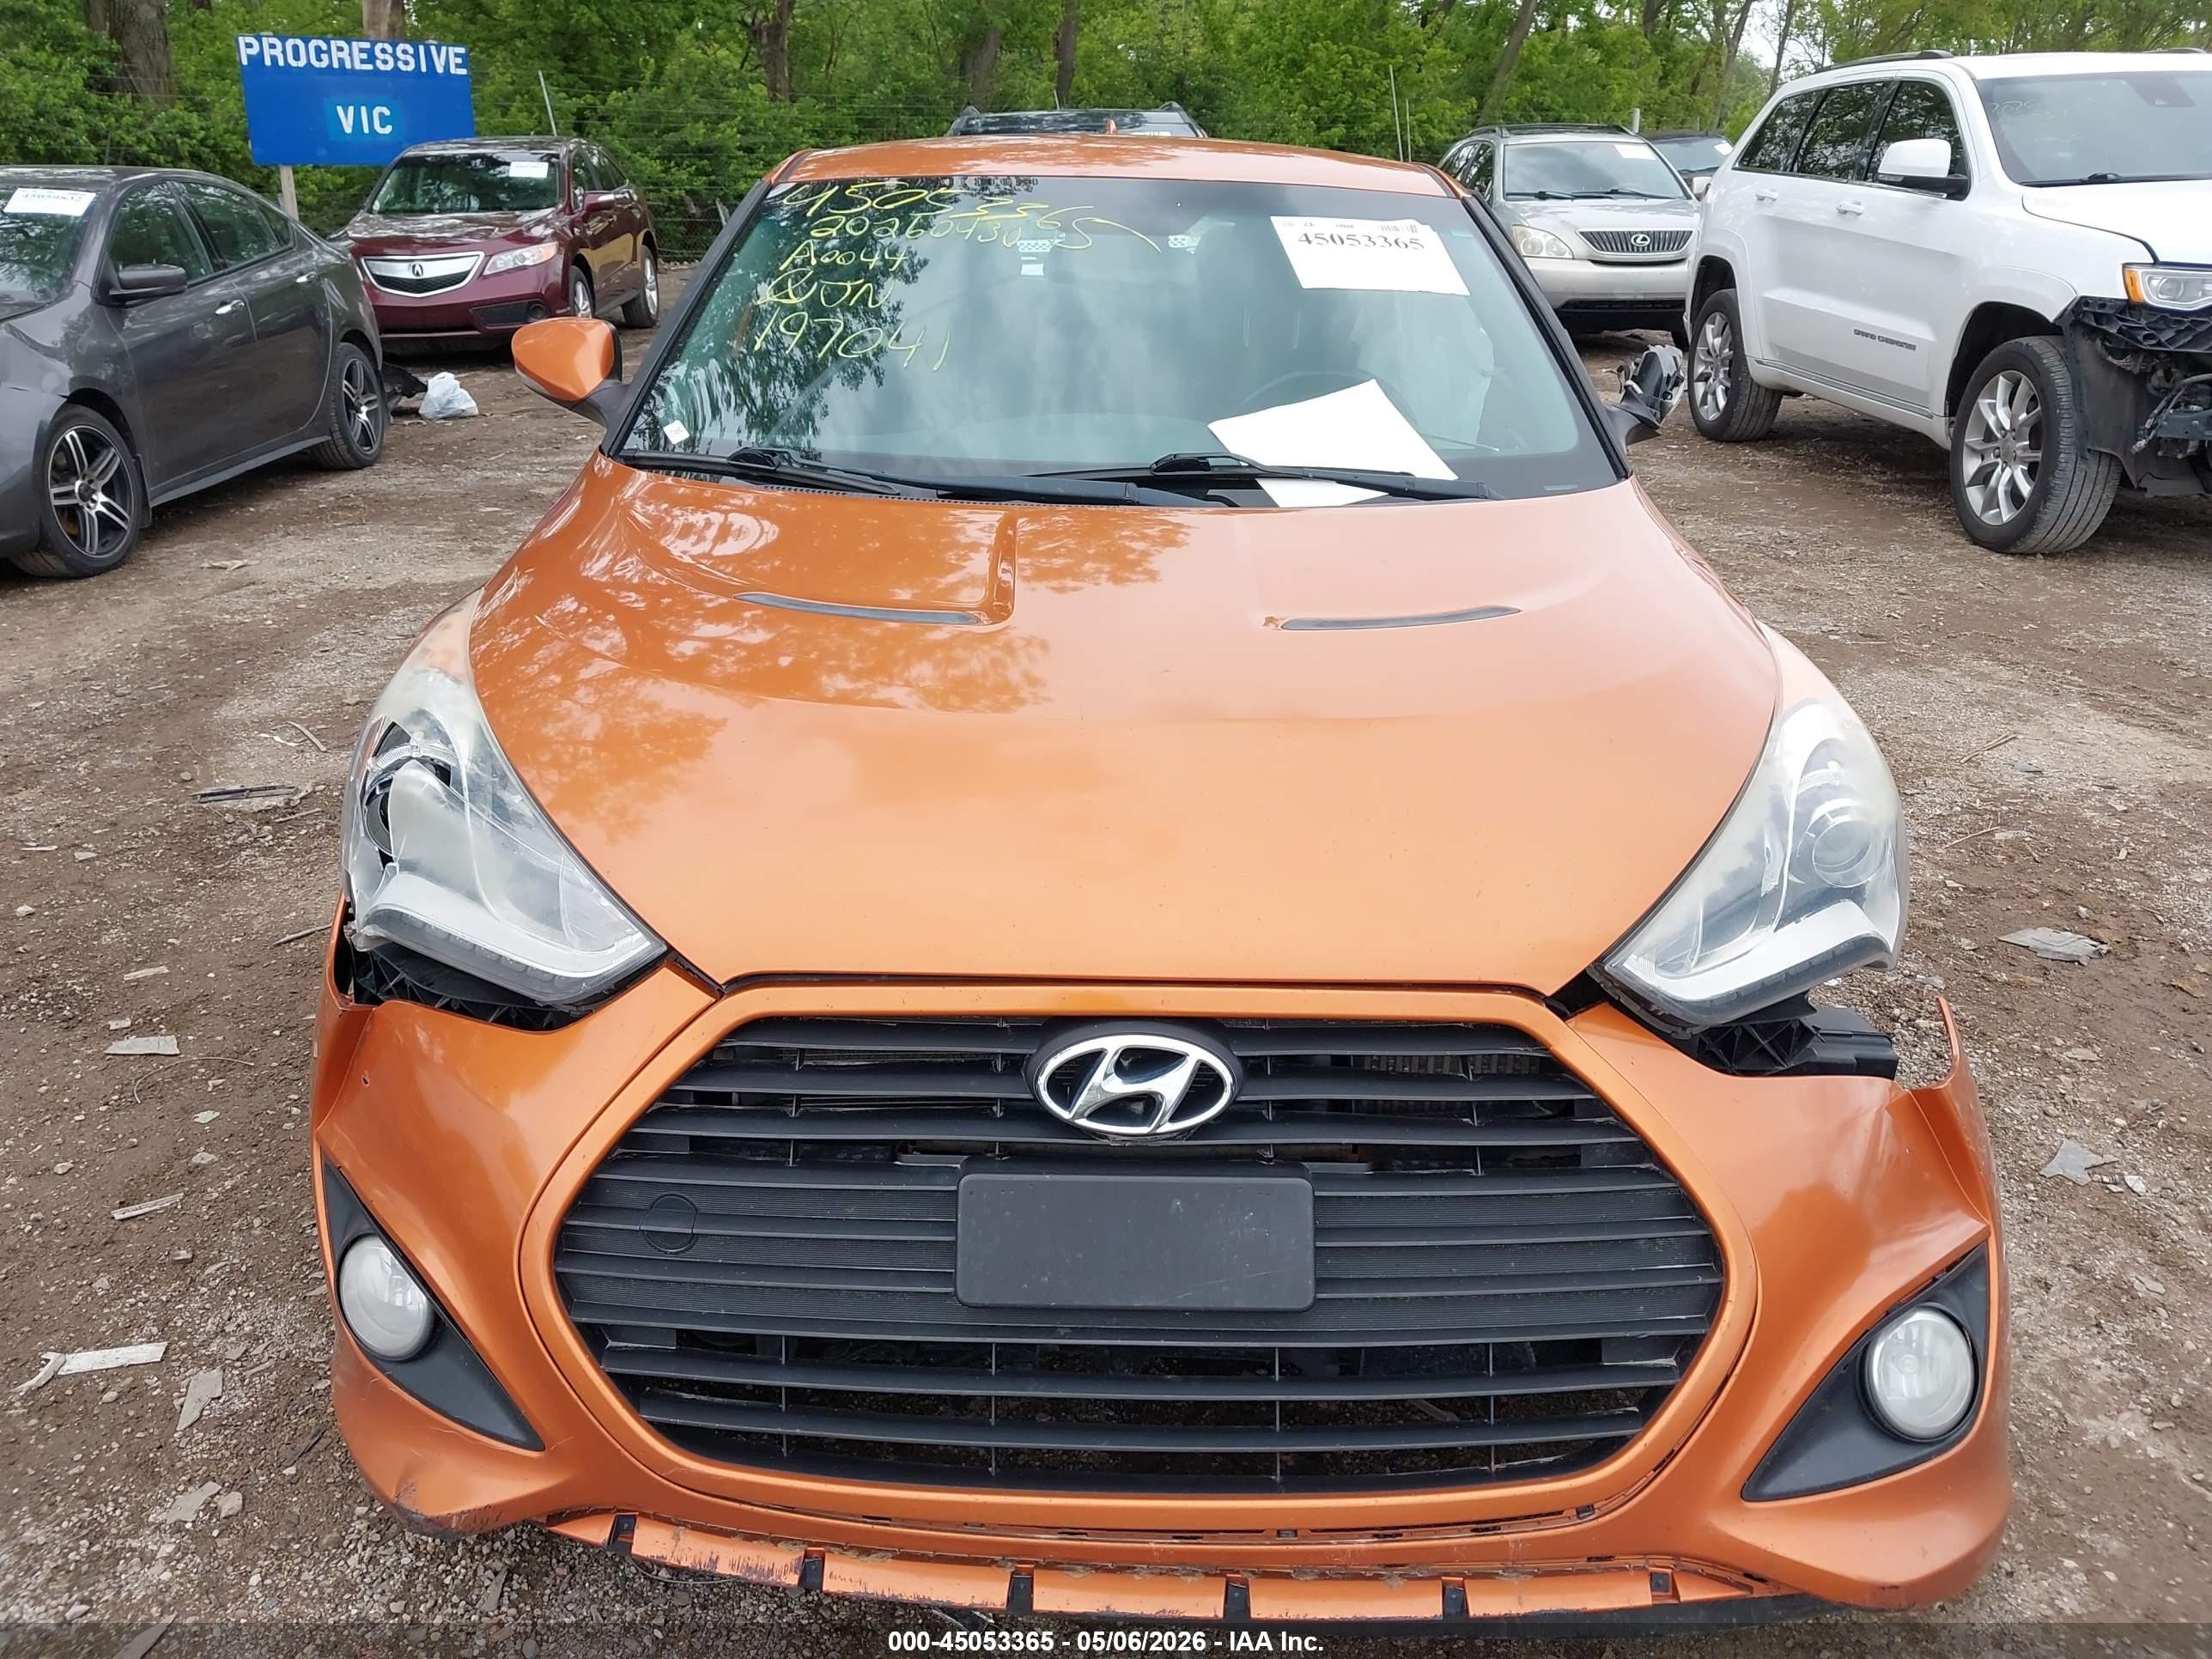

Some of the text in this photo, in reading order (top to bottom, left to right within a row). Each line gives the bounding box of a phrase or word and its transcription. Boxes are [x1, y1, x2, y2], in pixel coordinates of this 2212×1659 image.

[238, 36, 468, 76] PROGRESSIVE
[336, 105, 393, 135] VIC
[1297, 232, 1425, 251] 45053365
[753, 305, 951, 372] 197041
